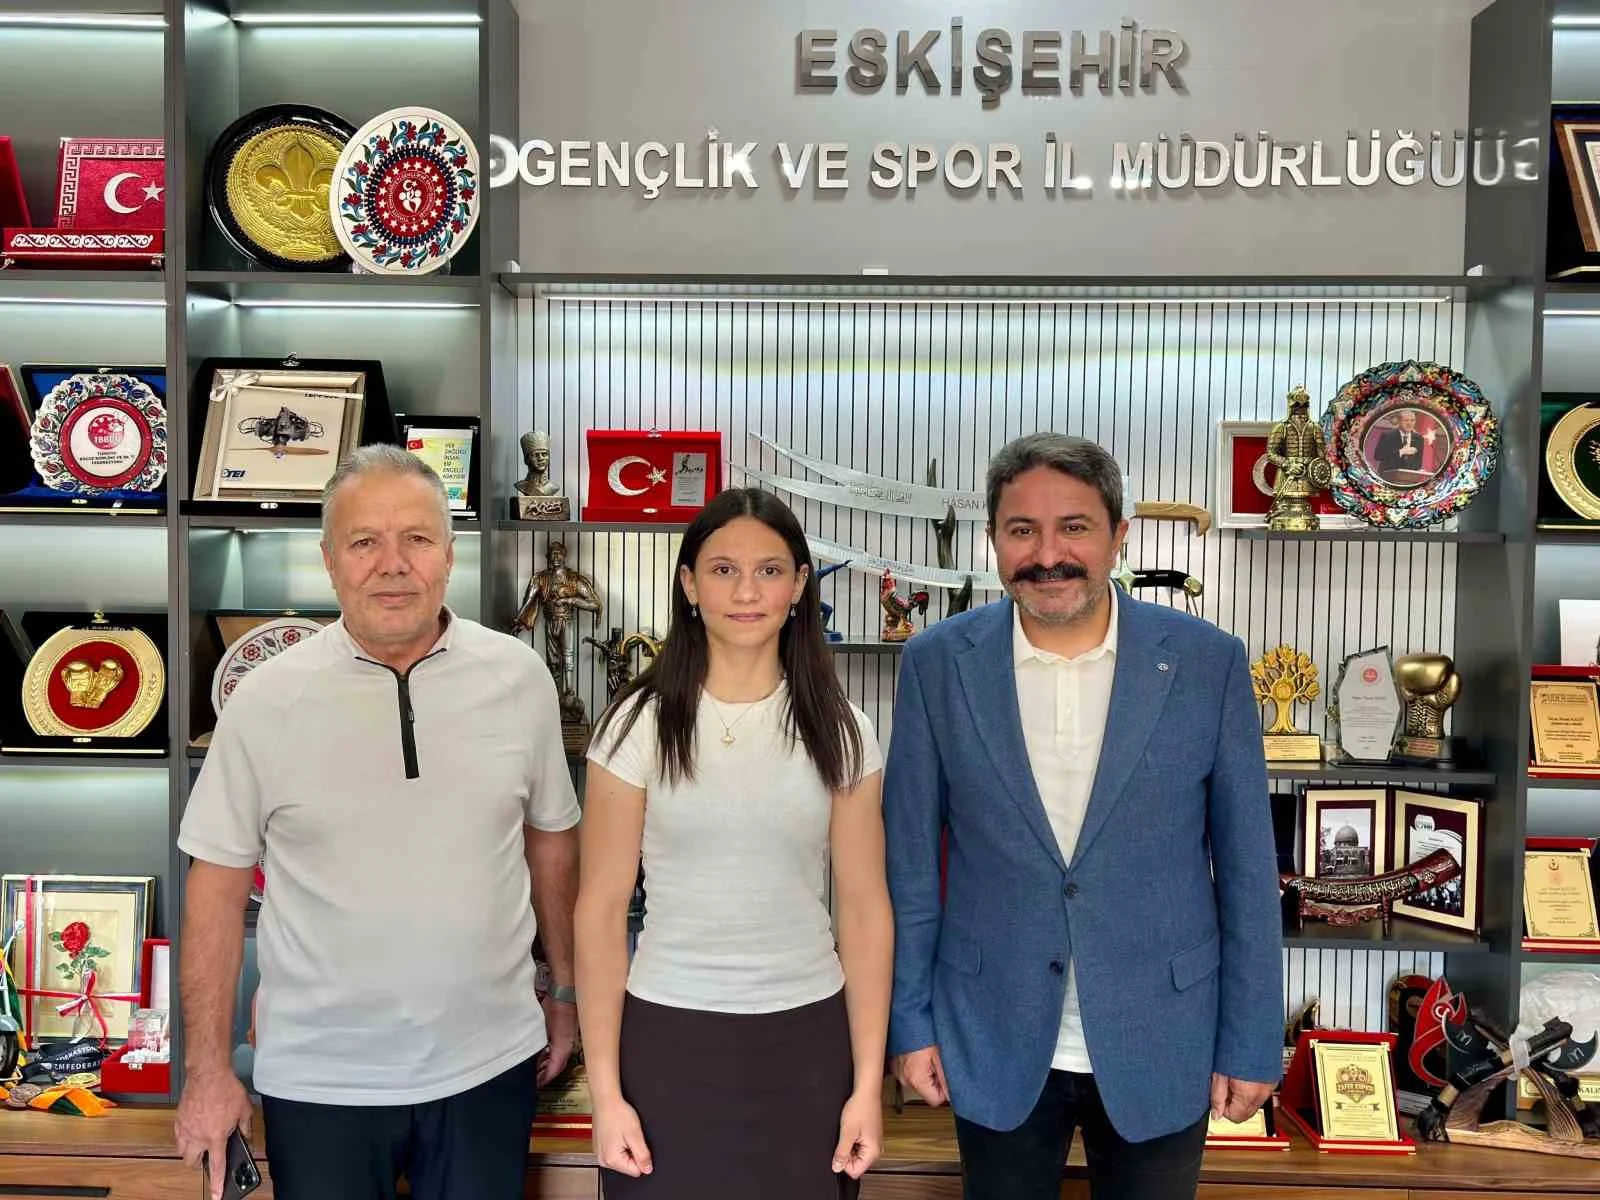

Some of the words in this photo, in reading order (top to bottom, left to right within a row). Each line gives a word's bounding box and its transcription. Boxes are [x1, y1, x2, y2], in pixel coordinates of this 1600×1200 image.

[797, 15, 1187, 109] ESKİŞEHİR
[518, 127, 760, 200] GENÇLİK
[777, 142, 849, 190] VE
[870, 142, 1023, 190] SPOR
[1043, 132, 1093, 190] İL
[1110, 128, 1465, 190] MÜDÜRLÜĞÜ
[942, 496, 980, 510] HASAN
